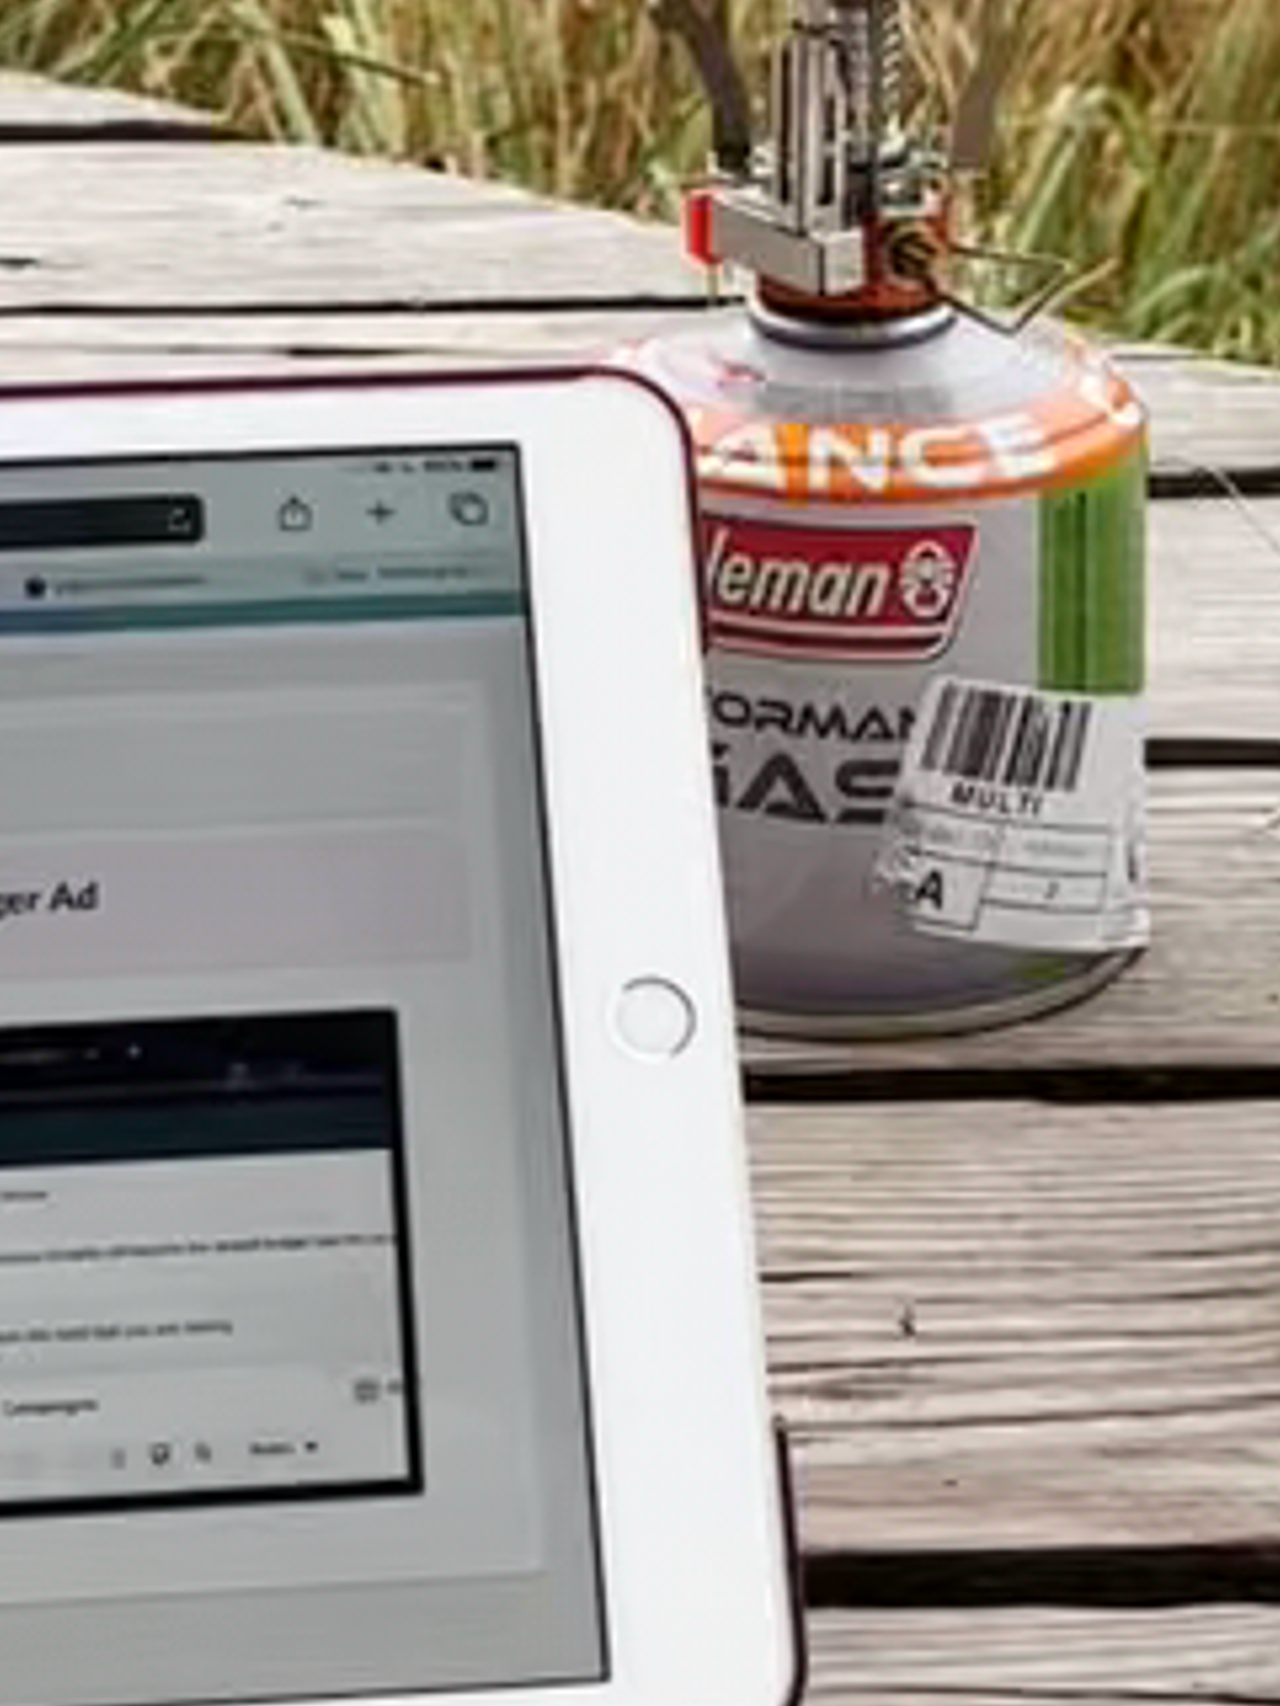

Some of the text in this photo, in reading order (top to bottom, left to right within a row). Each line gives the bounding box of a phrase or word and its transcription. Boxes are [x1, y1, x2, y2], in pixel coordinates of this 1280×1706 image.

[707, 528, 889, 616] leman
[951, 781, 1042, 816] MULTI
[49, 882, 99, 912] Ad
